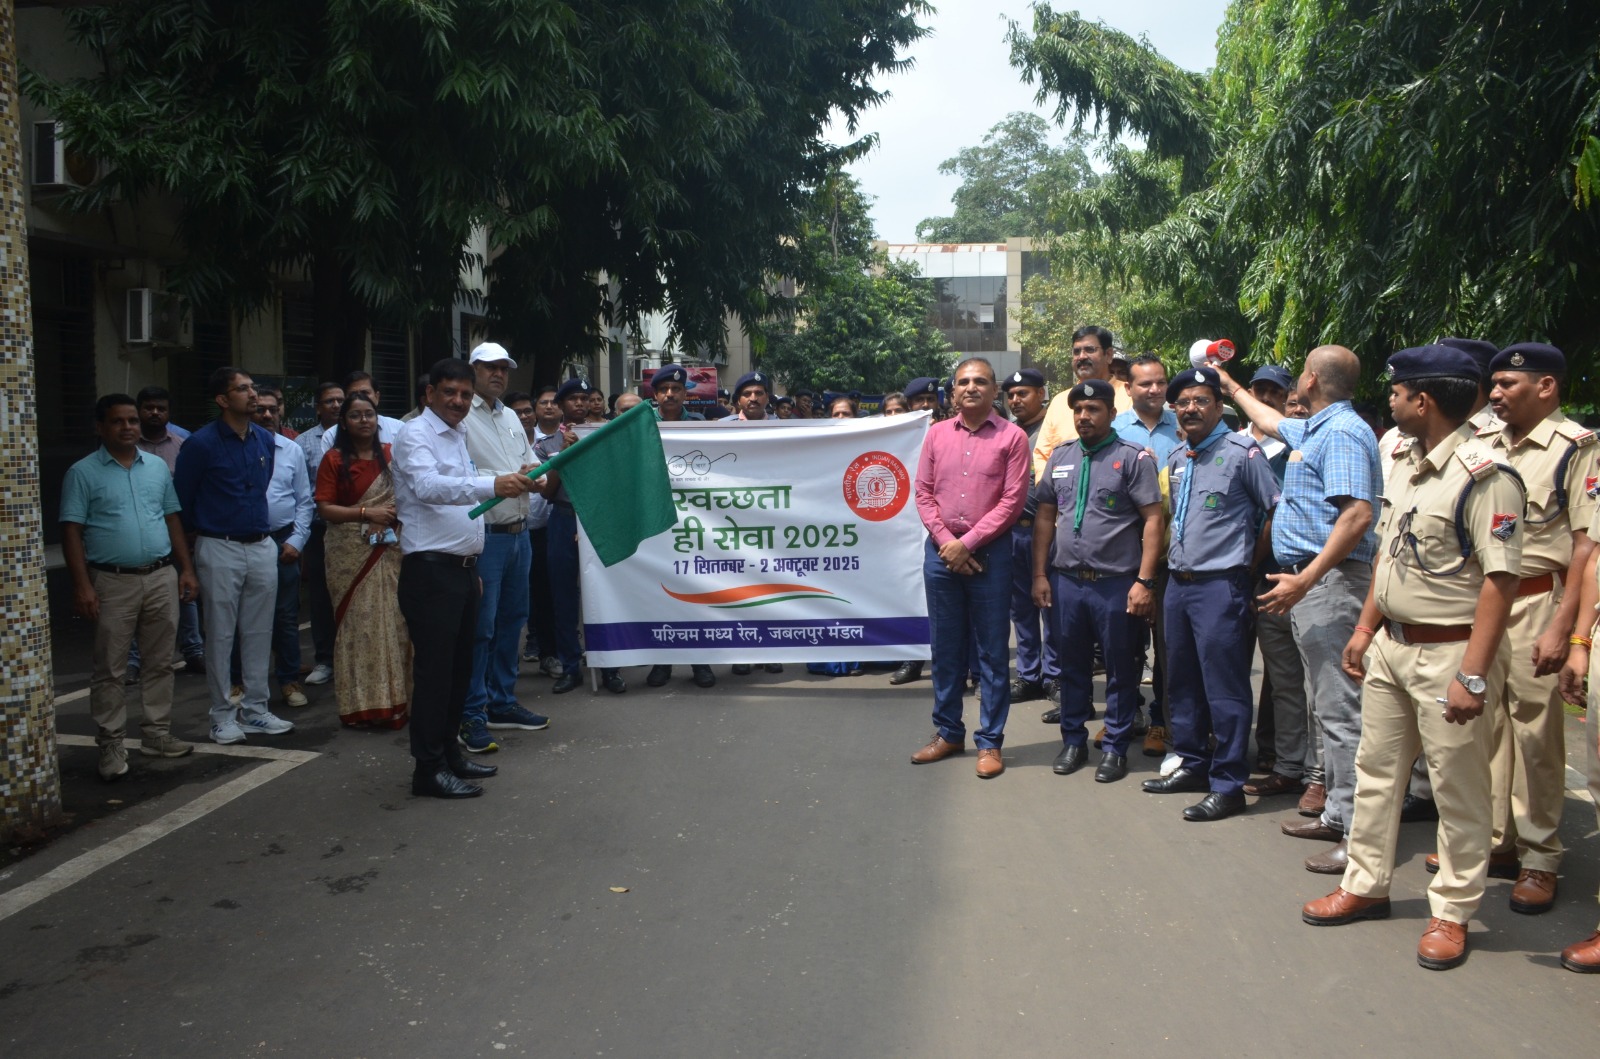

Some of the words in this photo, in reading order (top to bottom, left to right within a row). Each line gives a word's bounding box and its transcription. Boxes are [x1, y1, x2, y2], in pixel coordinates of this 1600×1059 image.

[871, 454, 891, 464] INDIAN
[843, 474, 853, 500] भारतीय
[848, 461, 860, 472] रेल
[671, 485, 792, 511] स्वच्छता
[672, 515, 705, 553] ही
[712, 515, 775, 550] सेवा
[783, 523, 859, 549] 2025
[673, 560, 689, 575] 17
[694, 555, 745, 575] सितम्बर
[760, 558, 769, 573] 2
[773, 556, 819, 577] अक्टूबर
[823, 556, 860, 571] 2025
[651, 624, 699, 643] पश्चिम
[703, 627, 733, 641] मध्य
[736, 623, 763, 643] रेल,
[768, 626, 825, 644] जबलपुर
[827, 622, 864, 640] मंडल
